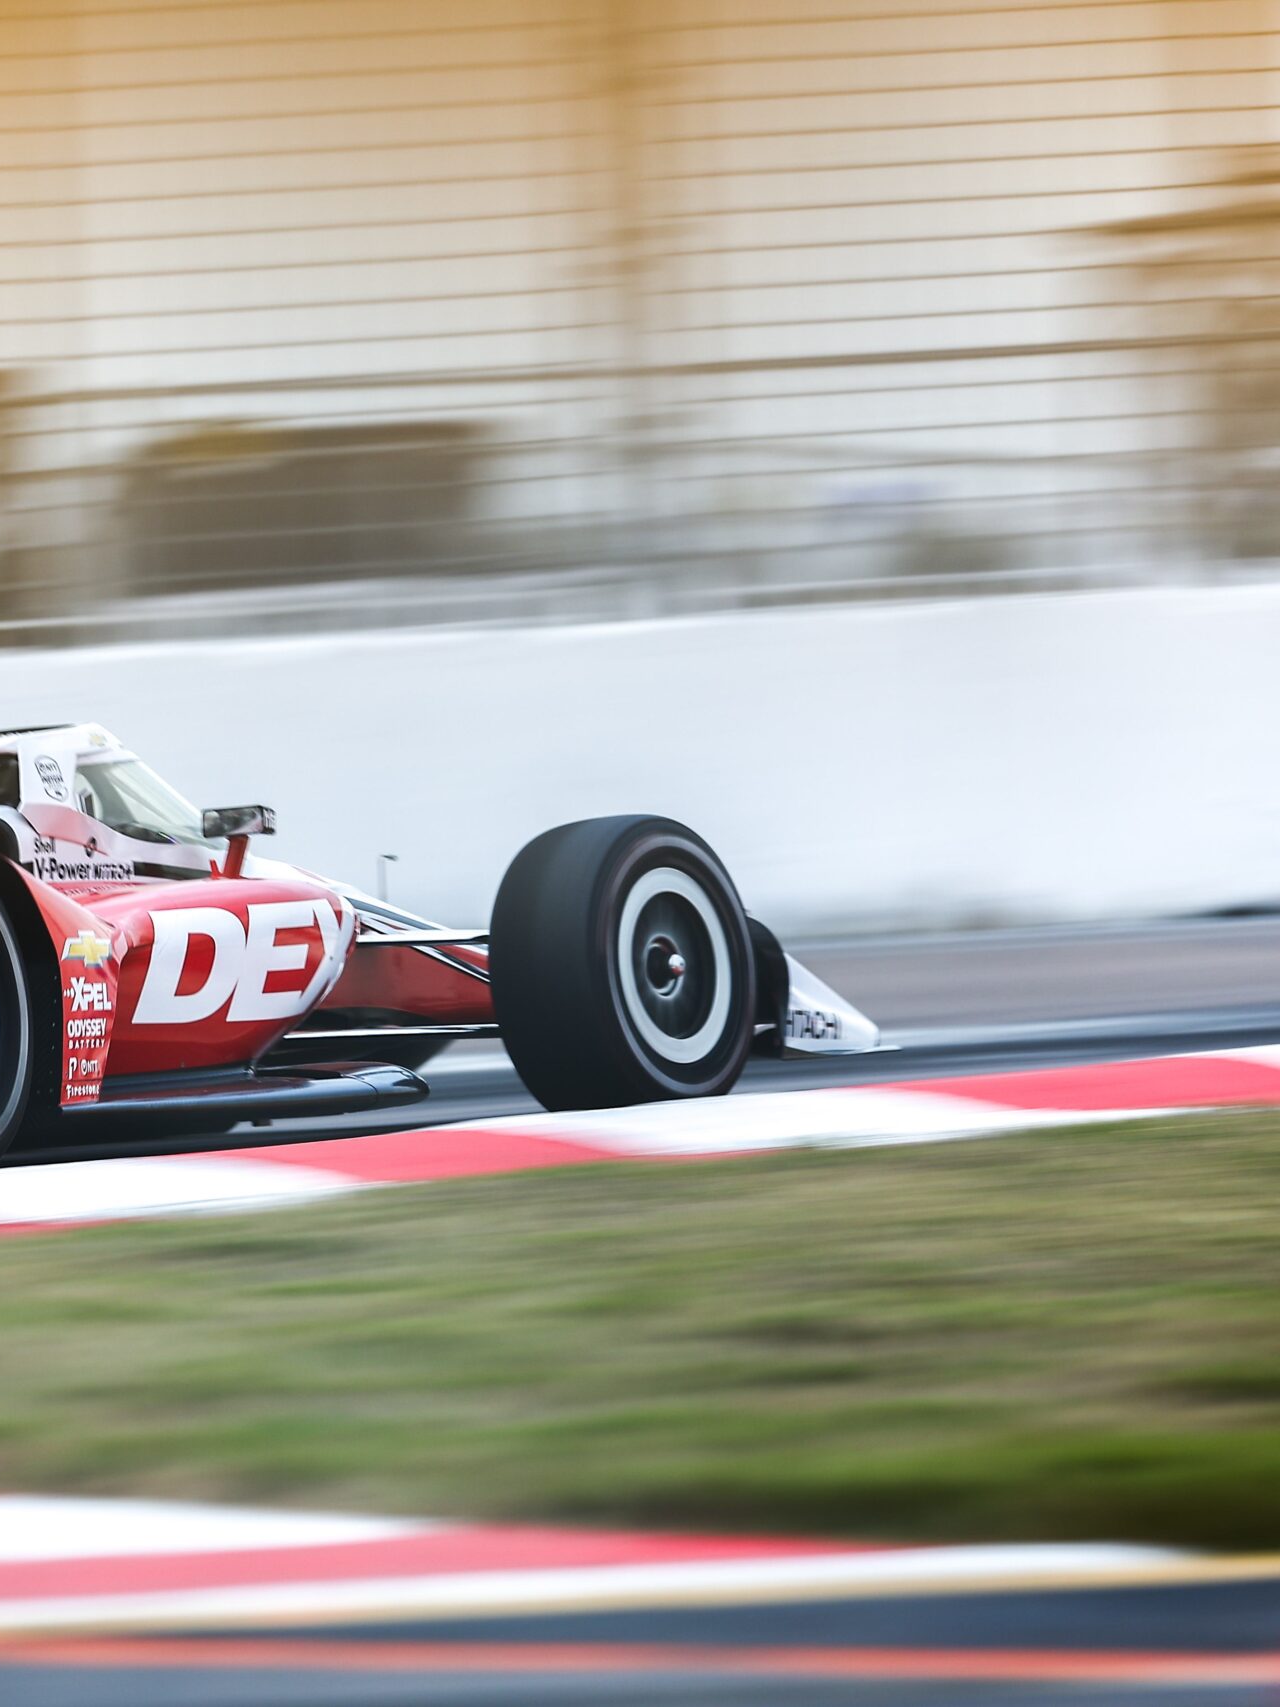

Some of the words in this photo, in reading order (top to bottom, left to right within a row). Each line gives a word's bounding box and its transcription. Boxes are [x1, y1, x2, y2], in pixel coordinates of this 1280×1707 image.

[34, 837, 55, 854] Shell
[34, 857, 92, 880] V-Power
[131, 896, 356, 1024] DEX
[70, 976, 112, 1011] XPEL
[67, 1018, 107, 1038] ODYSSEY
[68, 1039, 105, 1049] BATTERY
[66, 1083, 100, 1099] Firestone
